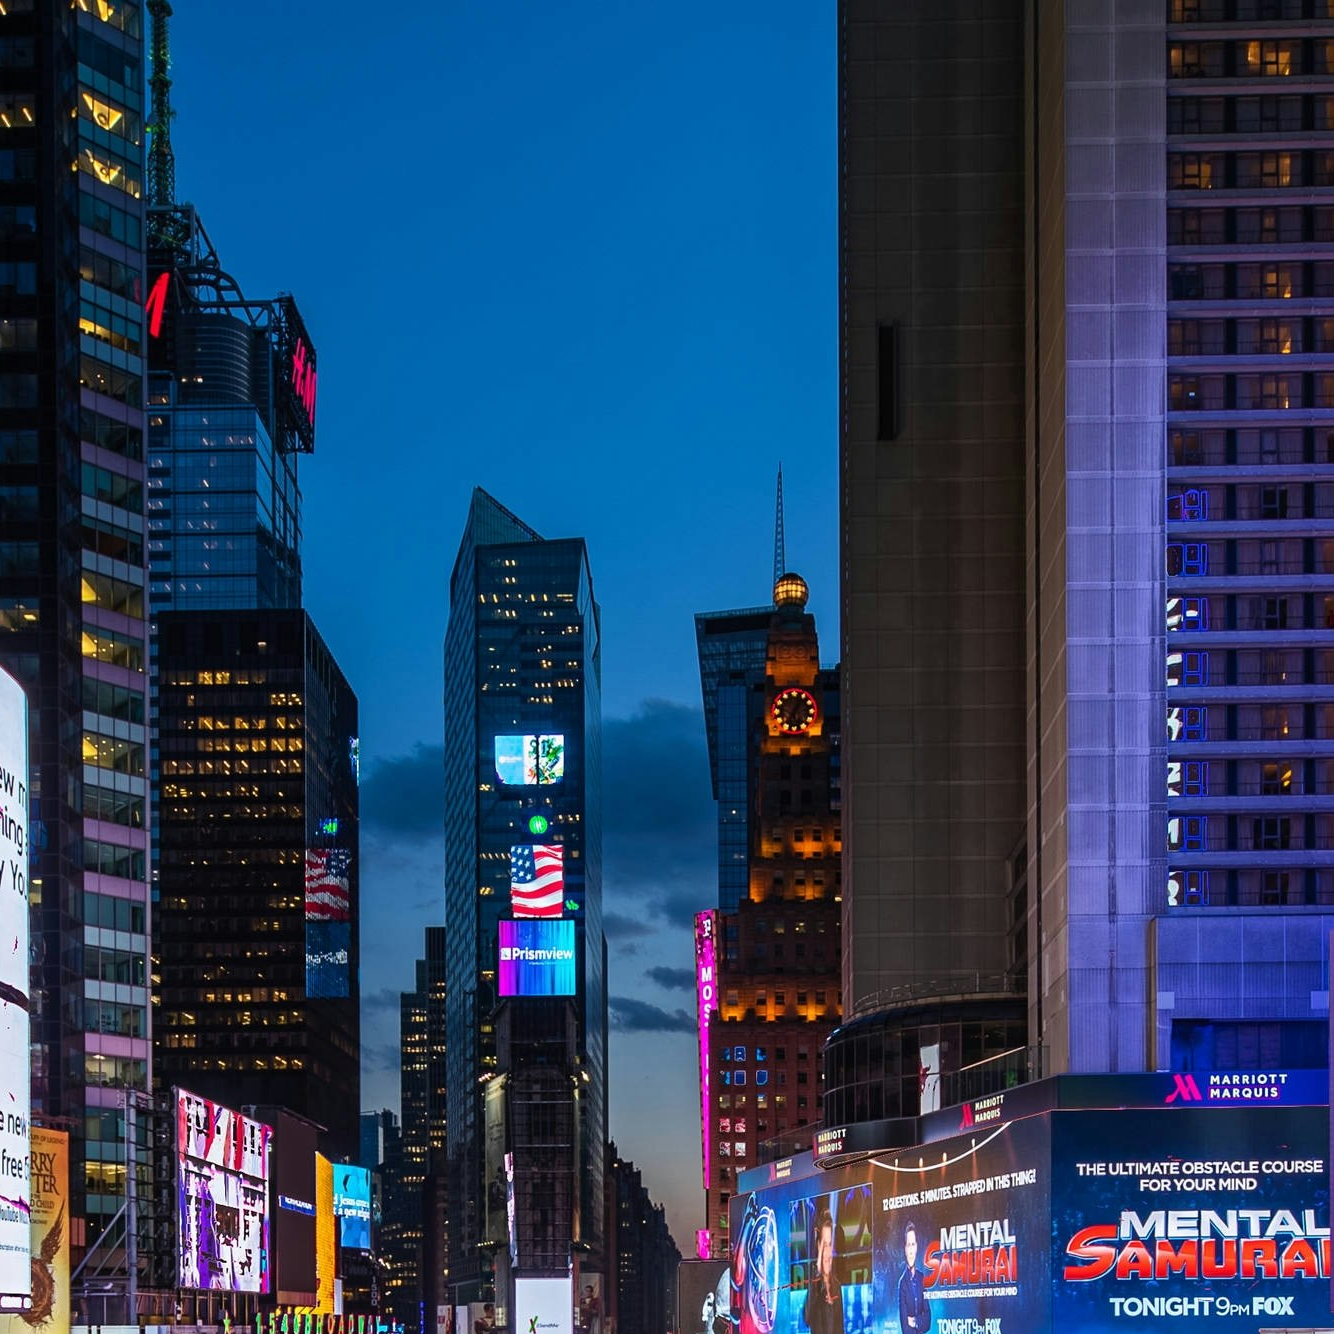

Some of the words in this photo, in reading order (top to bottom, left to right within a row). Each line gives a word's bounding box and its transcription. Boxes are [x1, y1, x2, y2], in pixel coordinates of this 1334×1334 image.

[512, 947, 573, 961] Prismview
[1209, 1073, 1288, 1086] MARRIOTT
[1209, 1086, 1280, 1098] MARQUIS
[975, 1095, 1005, 1112] MARRIOTT
[975, 1108, 1001, 1123] MARQUIS
[1076, 1162, 1105, 1176] THE
[1108, 1161, 1178, 1176] ULTIMATE
[1181, 1160, 1258, 1175] OBSTACLE
[1261, 1159, 1323, 1174] COURSE
[1139, 1178, 1168, 1192] FOR
[1170, 1178, 1212, 1192] YOUR
[1216, 1177, 1257, 1191] MIND
[1119, 1209, 1331, 1240] MENTAL
[940, 1218, 1016, 1251] MENTAL
[923, 1240, 1017, 1289] SAMURAI
[1109, 1297, 1213, 1317] TONIGHT
[1252, 1296, 1295, 1316] FOX
